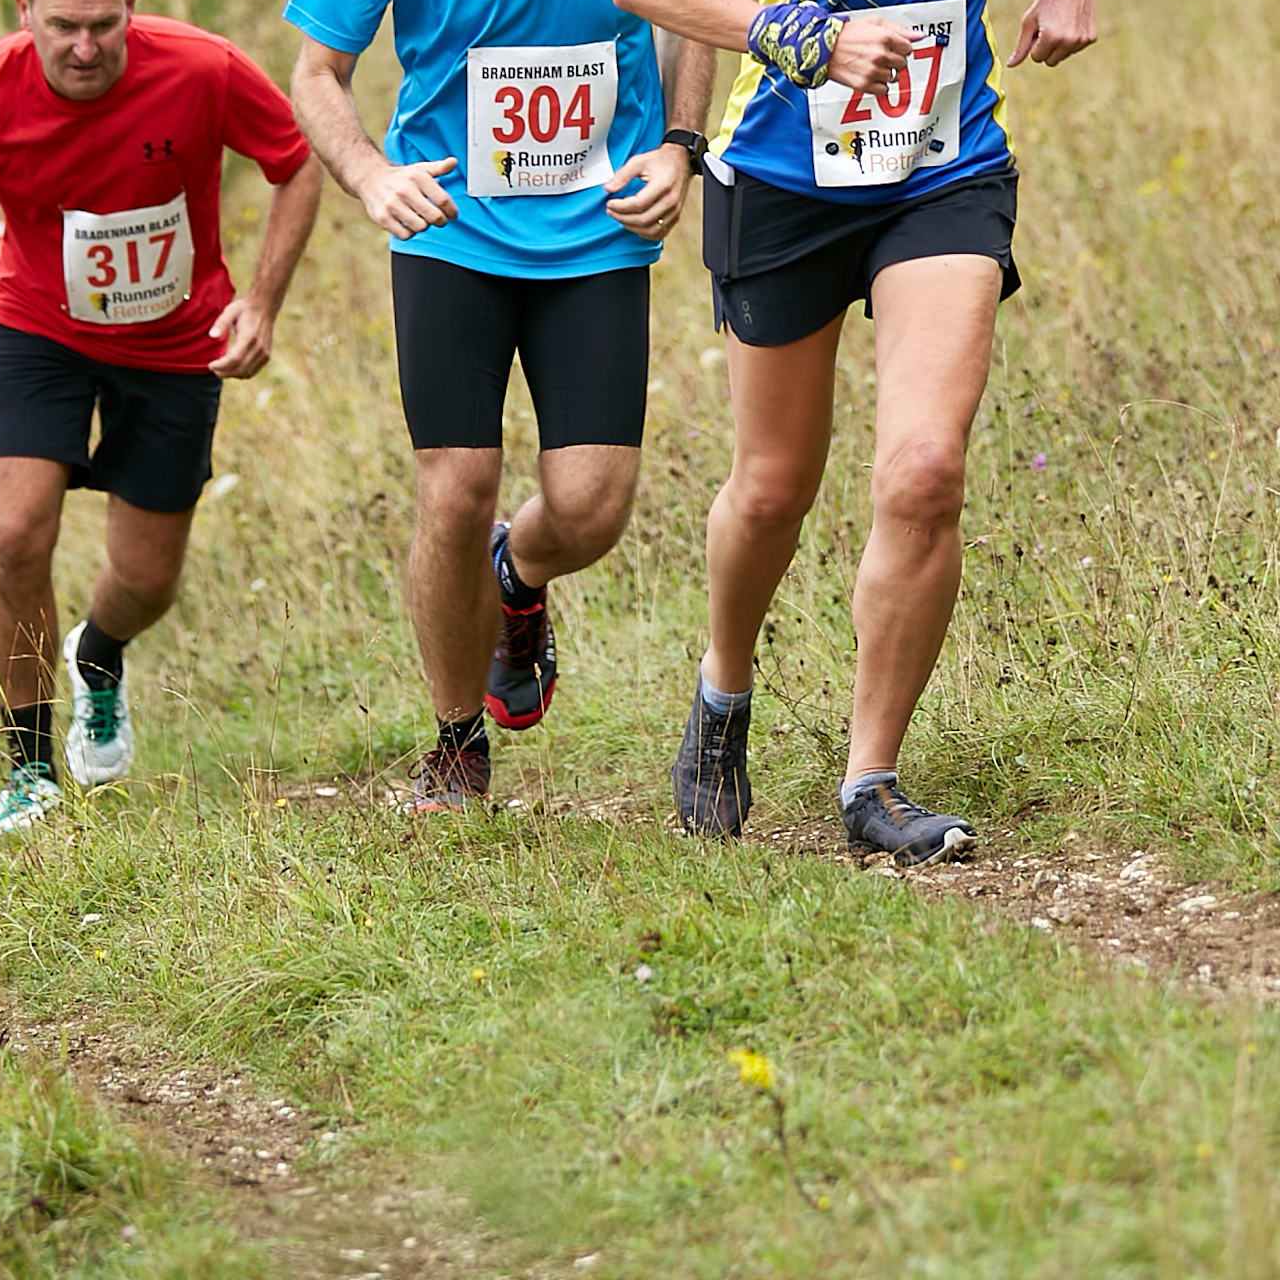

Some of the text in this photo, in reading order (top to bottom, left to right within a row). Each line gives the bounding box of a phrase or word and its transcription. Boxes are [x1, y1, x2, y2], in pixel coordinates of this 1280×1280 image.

[481, 62, 605, 80] BRADENHAM BLAST
[492, 83, 595, 144] 304
[518, 145, 593, 168] Runners'
[517, 164, 585, 188] Retreat
[149, 212, 181, 232] BLAST
[86, 230, 177, 288] 317
